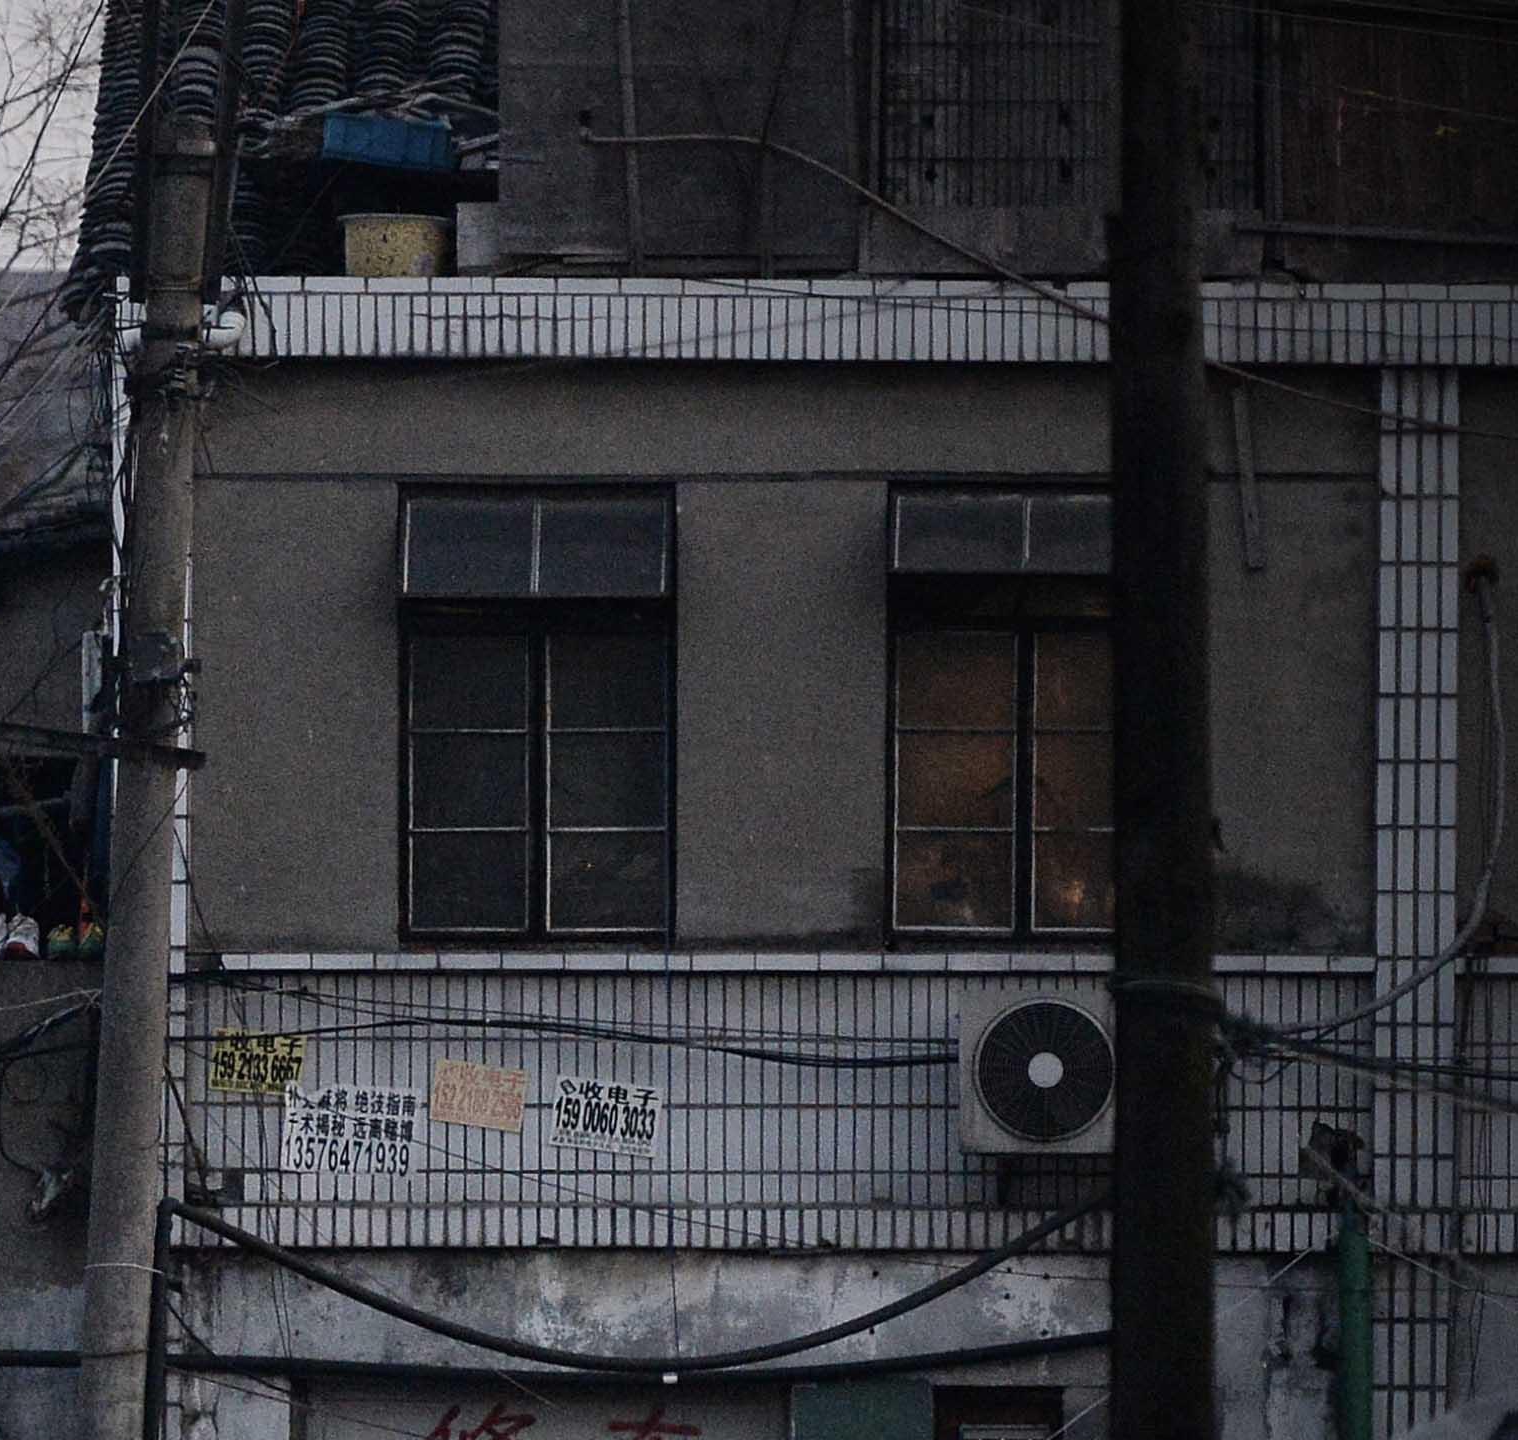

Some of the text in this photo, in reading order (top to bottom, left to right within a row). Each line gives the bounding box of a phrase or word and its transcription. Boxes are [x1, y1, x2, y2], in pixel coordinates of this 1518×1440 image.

[578, 1081, 659, 1107] 收电子
[555, 1096, 581, 1130] 159
[583, 1100, 618, 1136] 0060
[620, 1105, 655, 1140] 3033
[284, 1135, 410, 1177] 13576471939
